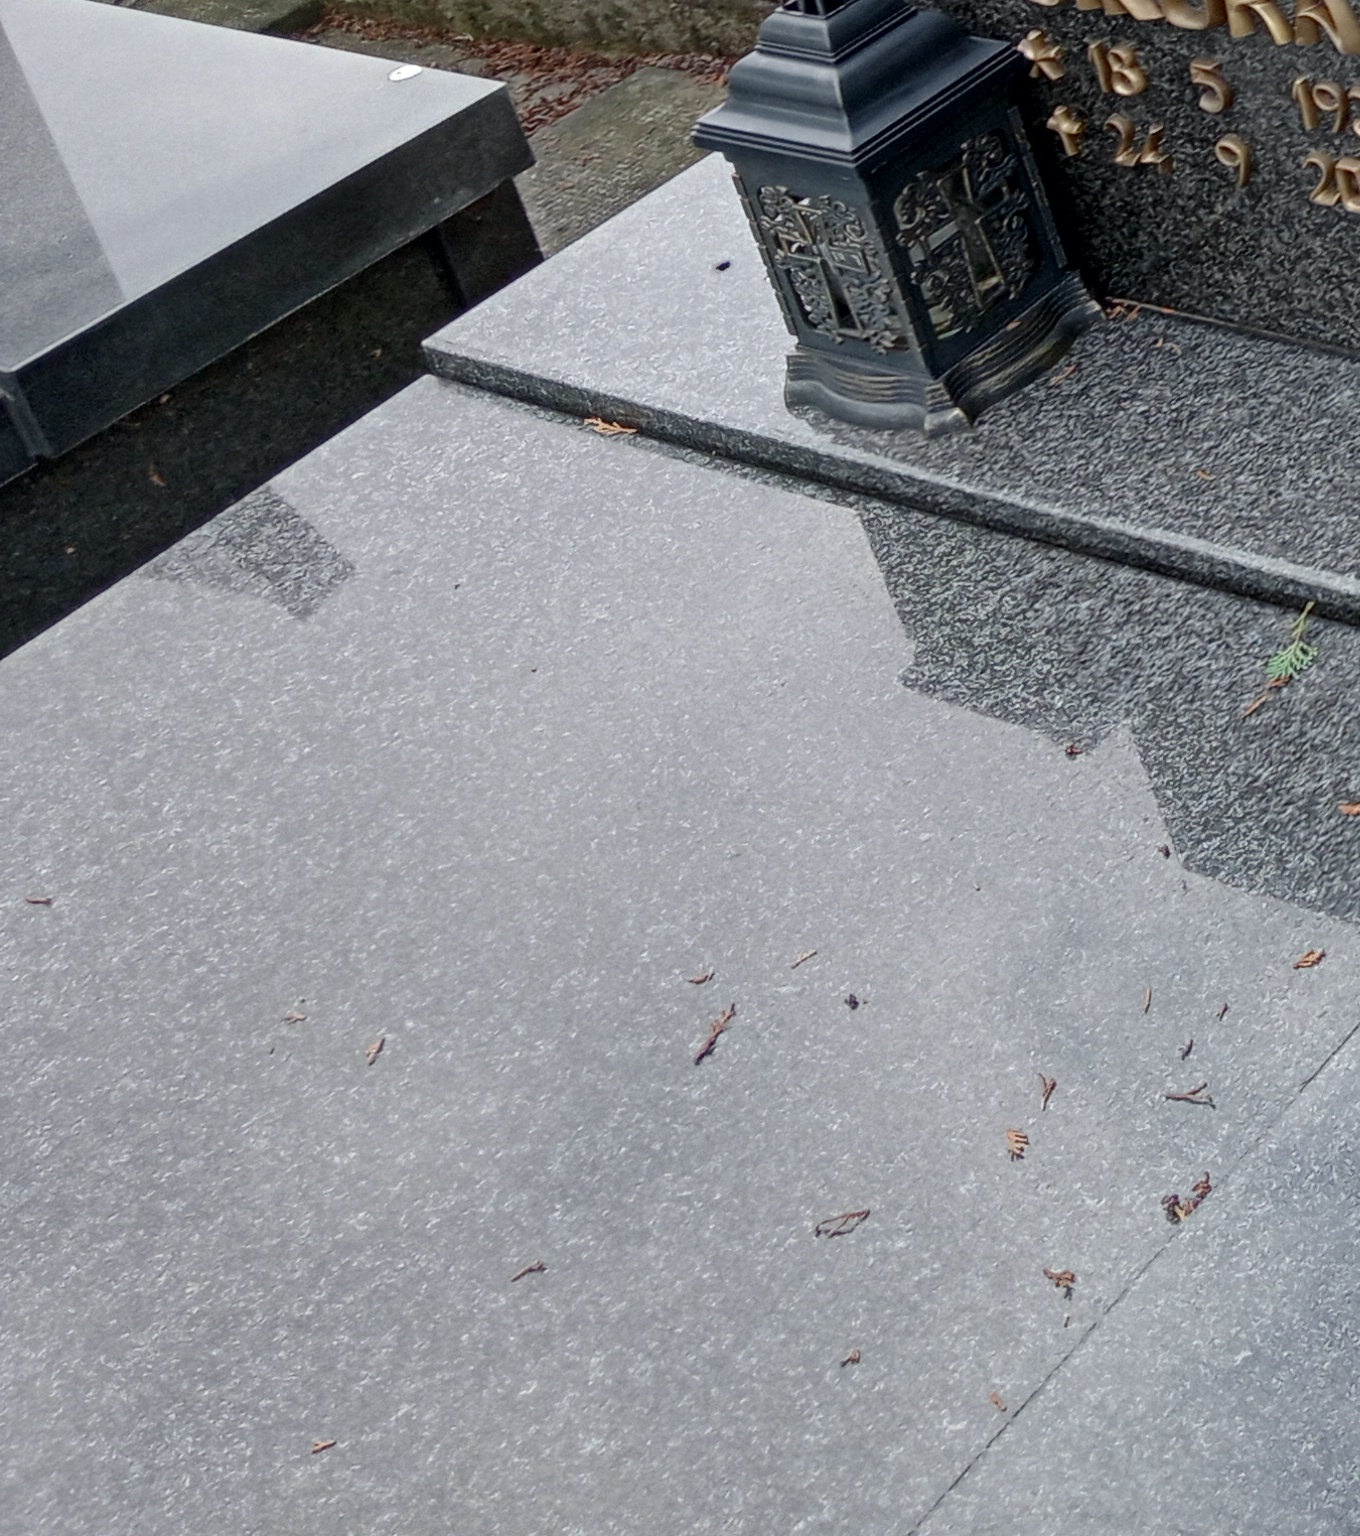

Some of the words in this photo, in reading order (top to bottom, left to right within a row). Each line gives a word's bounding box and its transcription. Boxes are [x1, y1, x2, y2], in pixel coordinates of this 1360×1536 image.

[1088, 39, 1148, 96] 18
[1190, 57, 1233, 114] 5
[1106, 112, 1174, 174] 24
[1215, 132, 1251, 186] 9
